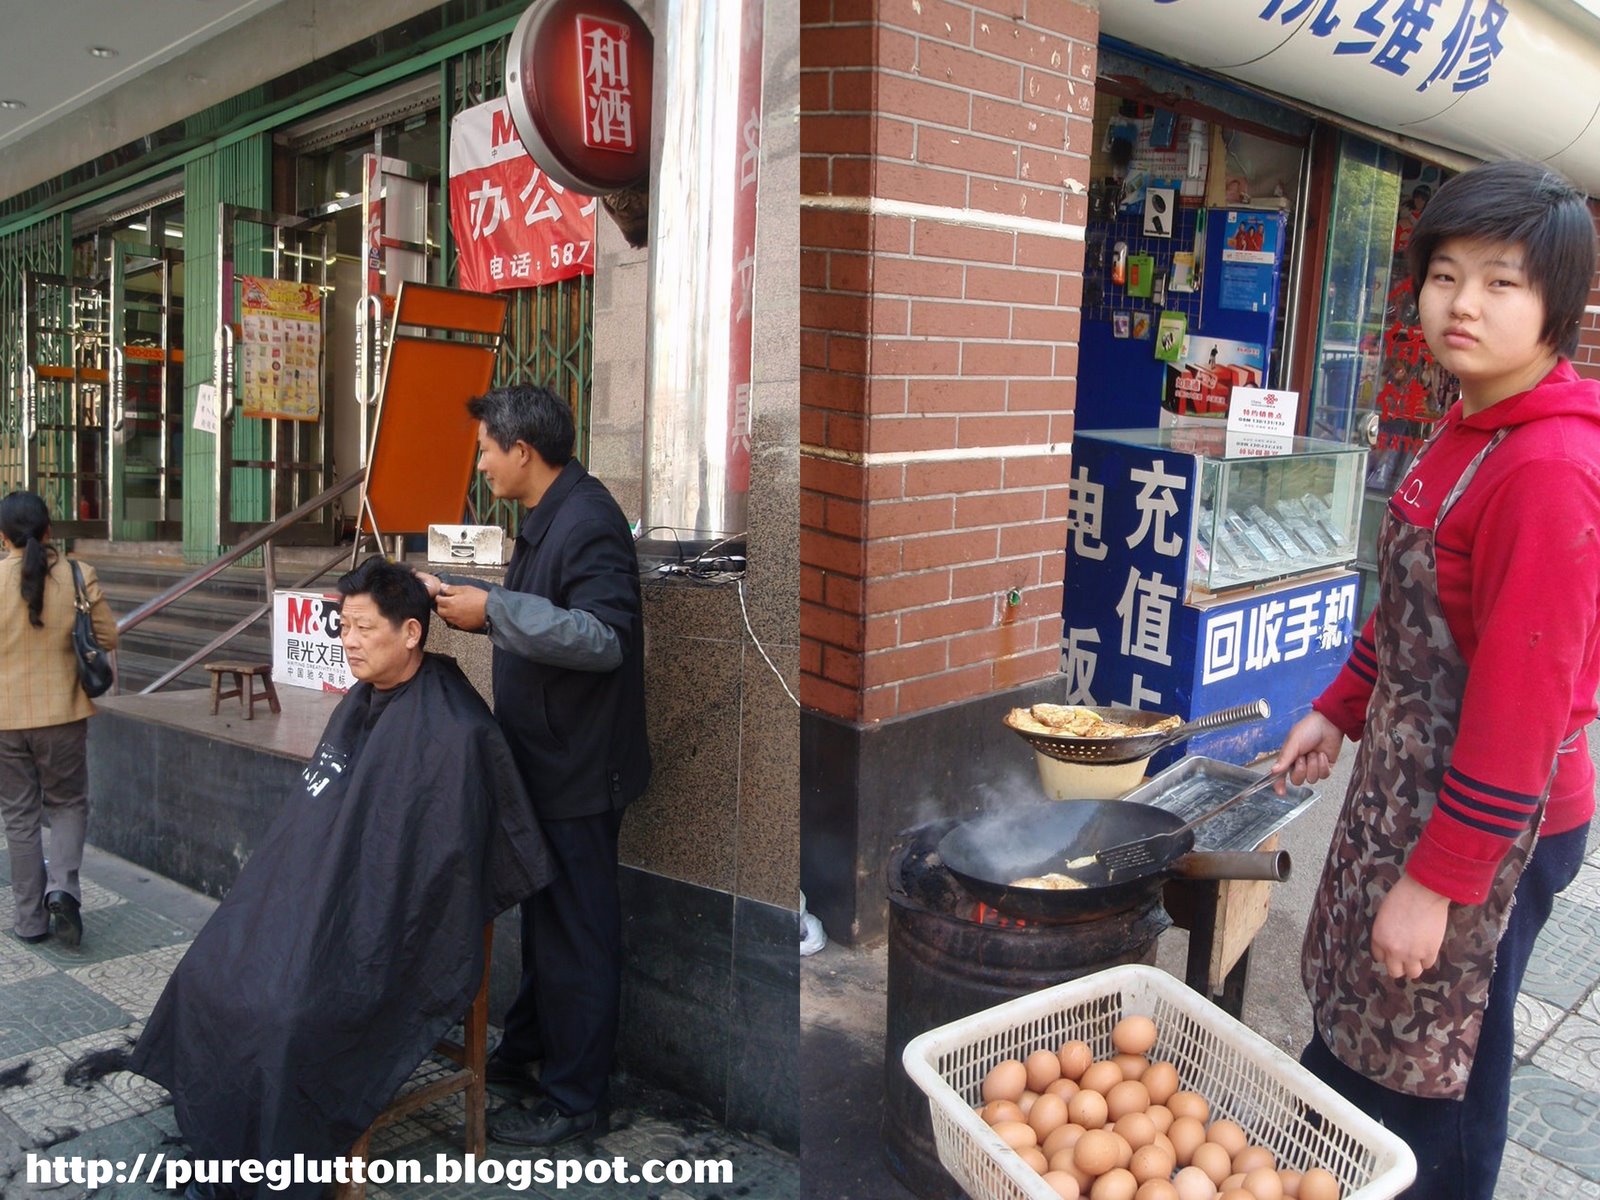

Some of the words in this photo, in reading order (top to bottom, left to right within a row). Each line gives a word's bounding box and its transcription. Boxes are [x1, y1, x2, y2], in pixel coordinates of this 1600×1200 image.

[584, 28, 632, 148] 和酒
[287, 638, 345, 668] 晨光文具
[1202, 584, 1356, 686] 回收手机
